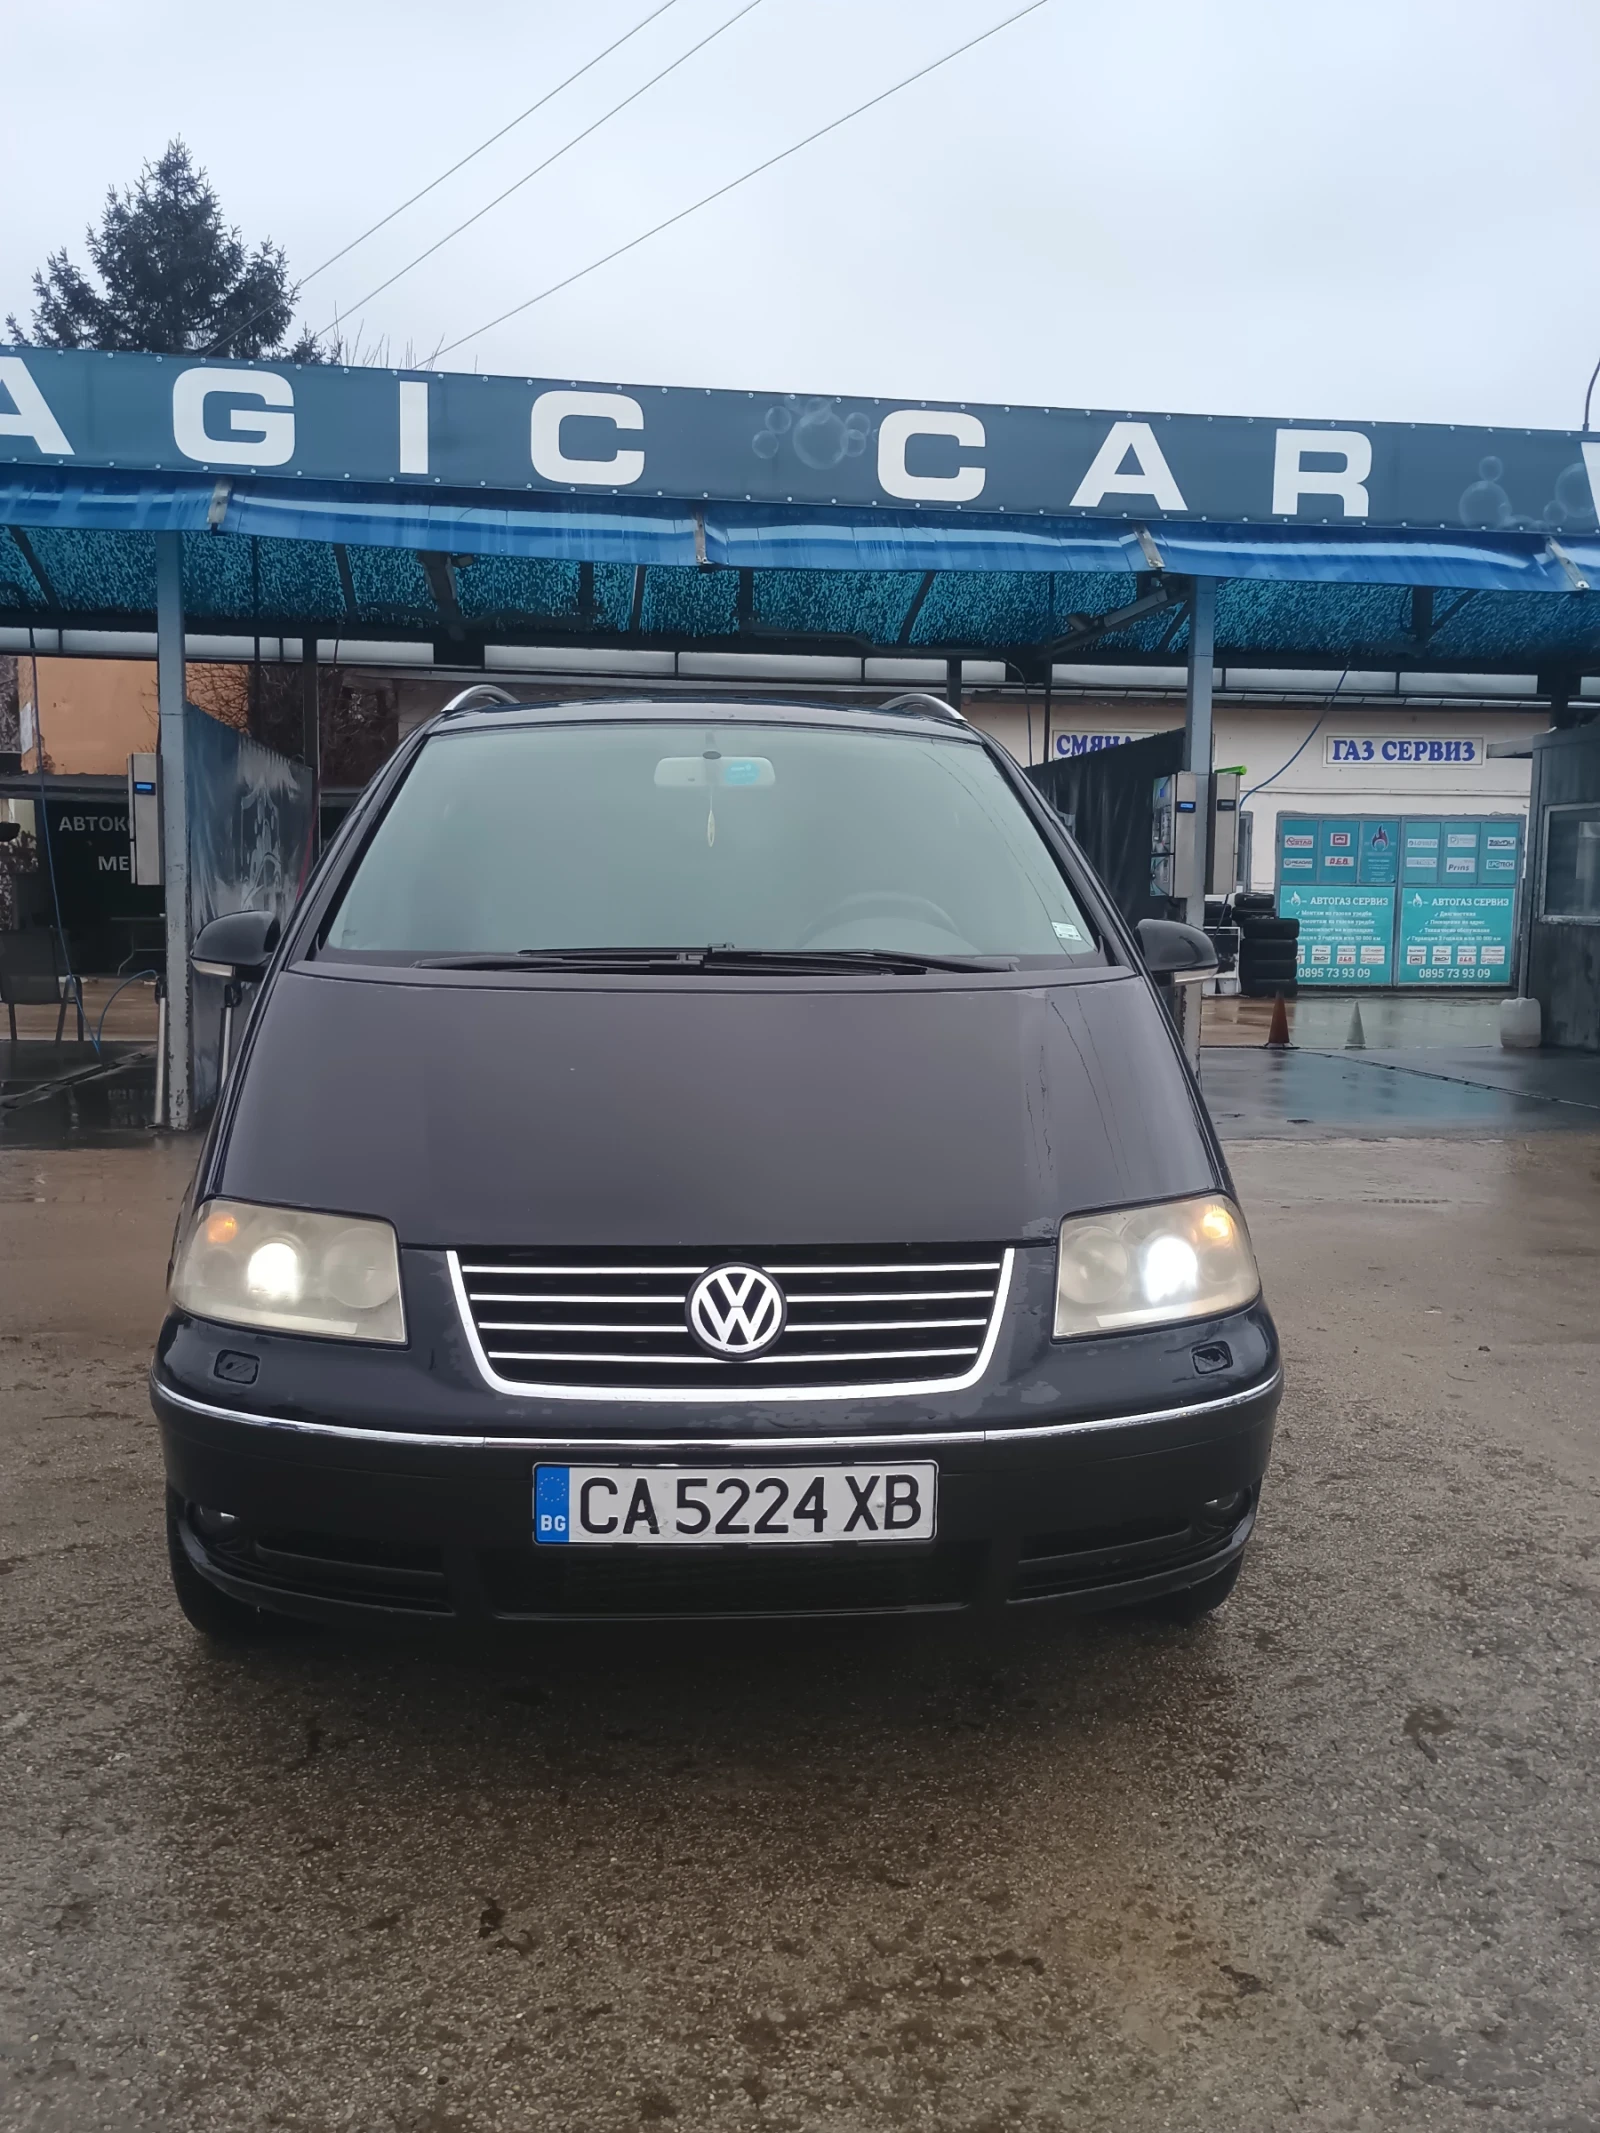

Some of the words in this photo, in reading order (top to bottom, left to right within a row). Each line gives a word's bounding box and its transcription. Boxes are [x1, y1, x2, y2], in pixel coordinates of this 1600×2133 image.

[876, 408, 1373, 518] CAR
[1332, 740, 1375, 760] ГАЗ
[1381, 741, 1475, 761] СЕРВИЗ
[1310, 897, 1350, 906] АВТОГАЗ
[1352, 898, 1388, 906] СЕРВИЗ
[1432, 898, 1472, 906] АВТОГАЗ
[1474, 898, 1509, 906] СЕРВИЗ
[1298, 968, 1324, 978] 0895
[1326, 968, 1340, 978] 73
[1342, 968, 1355, 978] 93
[1357, 968, 1370, 978] 09
[1418, 968, 1444, 978] 0895
[1446, 968, 1460, 978] 73
[1462, 968, 1475, 978] 93
[1477, 968, 1490, 978] 09
[675, 1476, 828, 1535] 5224
[540, 1514, 566, 1532] BG
